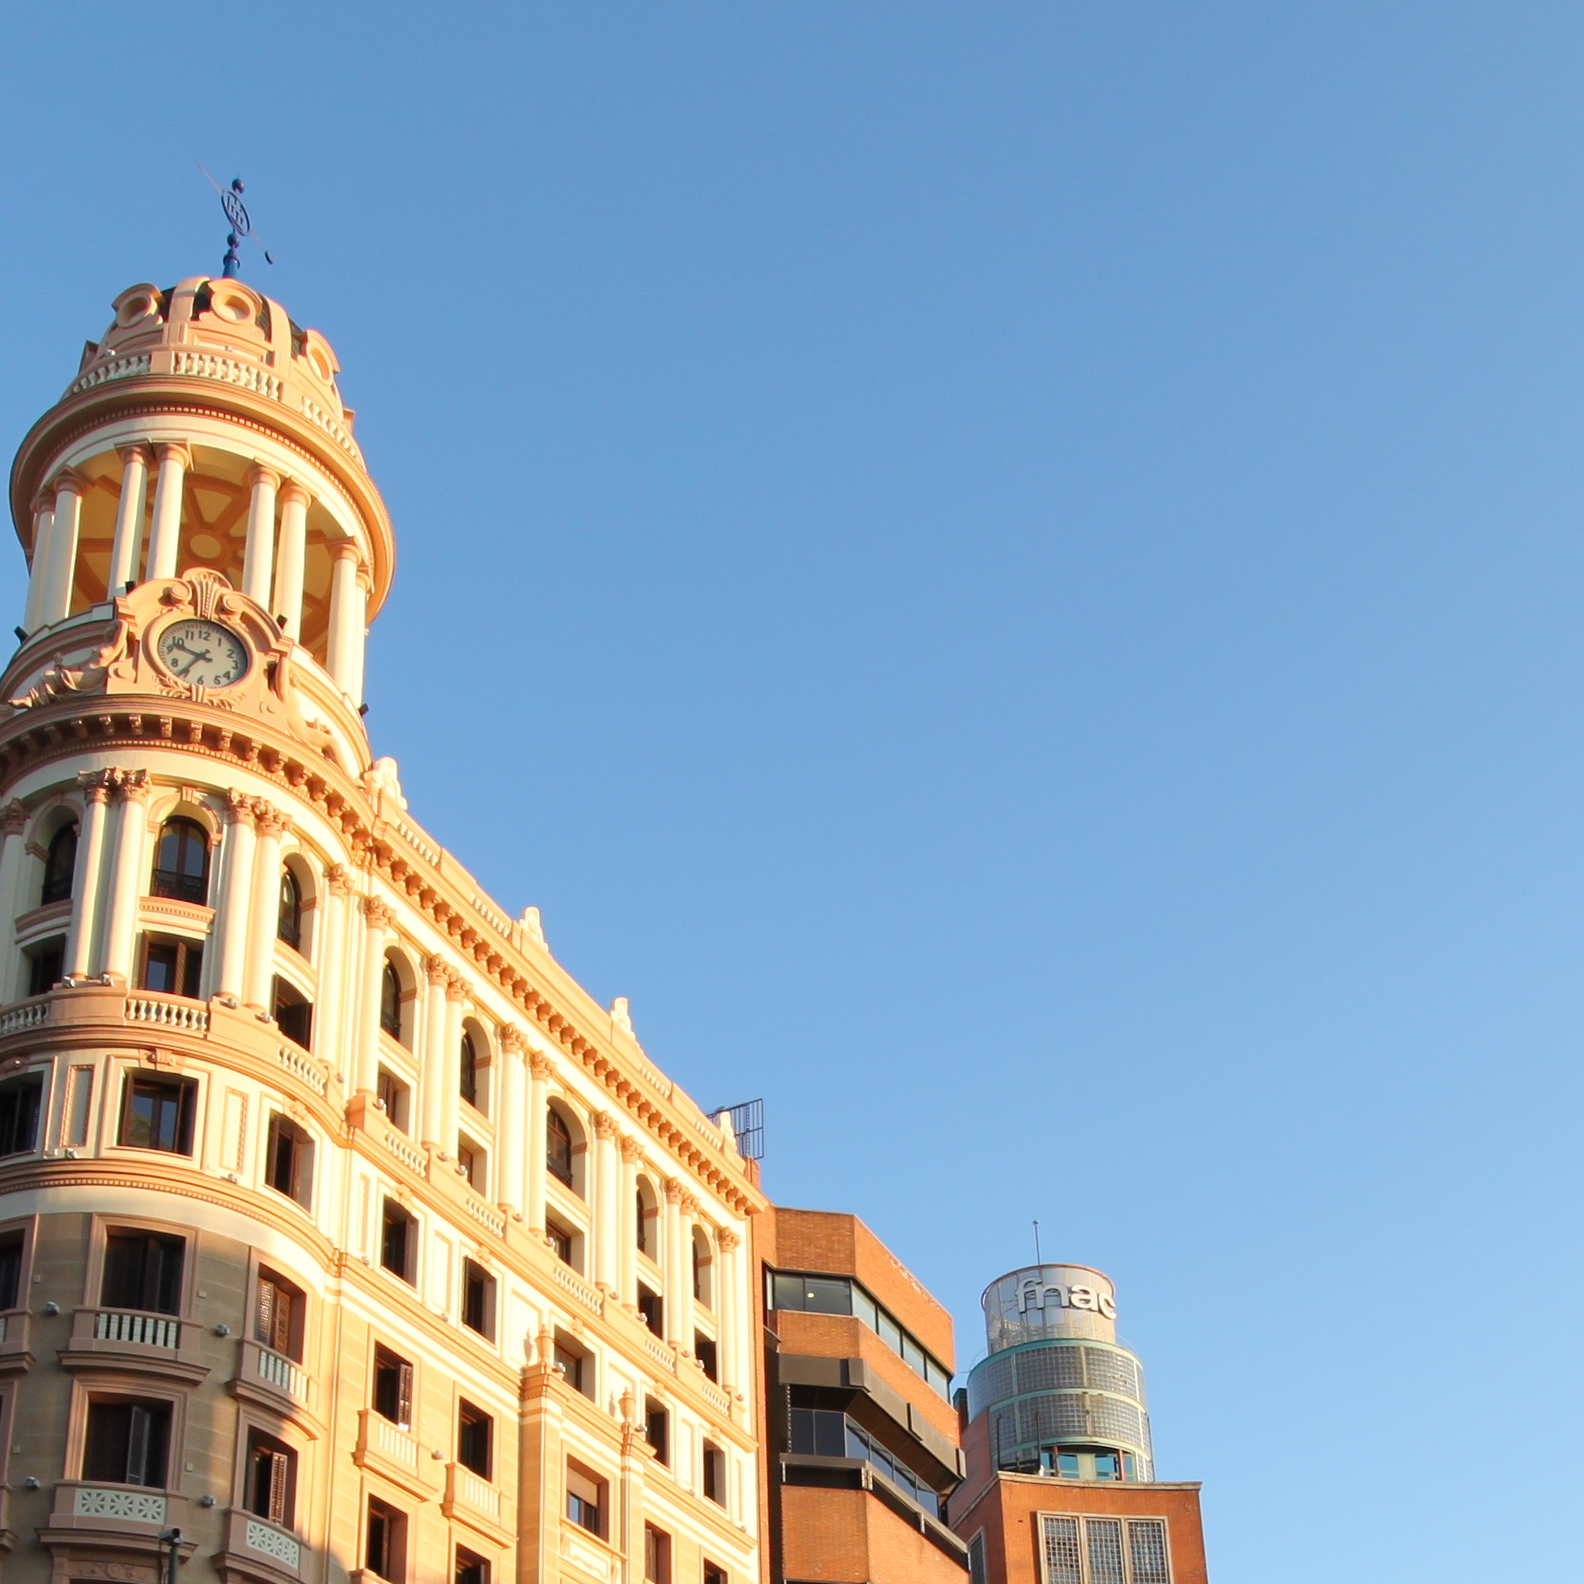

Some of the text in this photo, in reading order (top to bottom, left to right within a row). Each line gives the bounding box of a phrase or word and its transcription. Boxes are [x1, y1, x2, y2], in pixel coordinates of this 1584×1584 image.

[185, 630, 194, 640] 11
[198, 629, 211, 641] 12
[217, 637, 222, 647] 1
[226, 649, 235, 659] 2
[171, 658, 179, 668] 8
[231, 660, 238, 669] 3
[197, 675, 204, 685] 6
[213, 675, 221, 685] 5
[223, 671, 231, 679] 4
[1015, 1276, 1117, 1320] fnac
